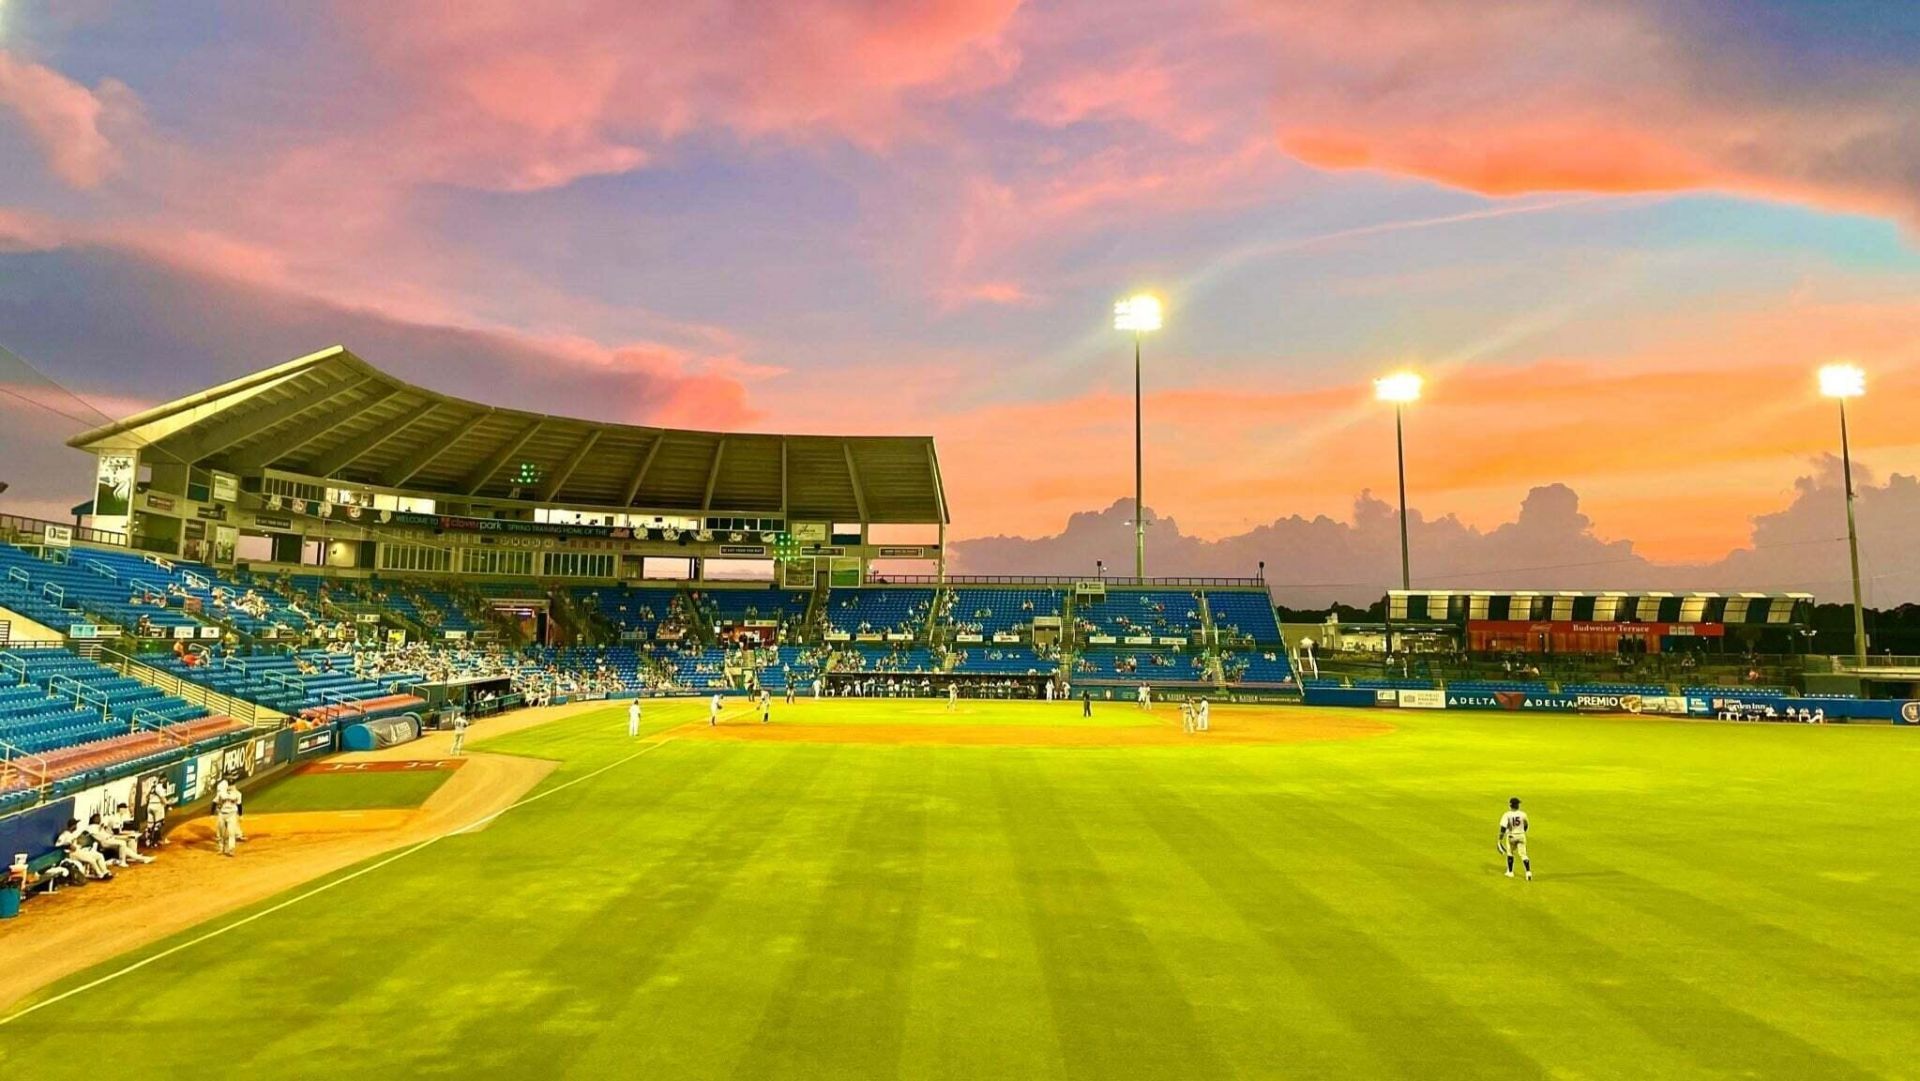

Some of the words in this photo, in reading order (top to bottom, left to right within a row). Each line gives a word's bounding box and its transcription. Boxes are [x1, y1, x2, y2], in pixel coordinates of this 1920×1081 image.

[396, 515, 427, 526] WELCOME
[451, 519, 479, 529] clover
[480, 519, 502, 530] park
[1573, 624, 1616, 632] Budweiser
[1619, 625, 1649, 633] Terrace
[1460, 697, 1496, 705] DELTA
[1536, 699, 1573, 707] DELTA
[1577, 696, 1618, 707] PREMIO
[1512, 816, 1521, 827] 15
